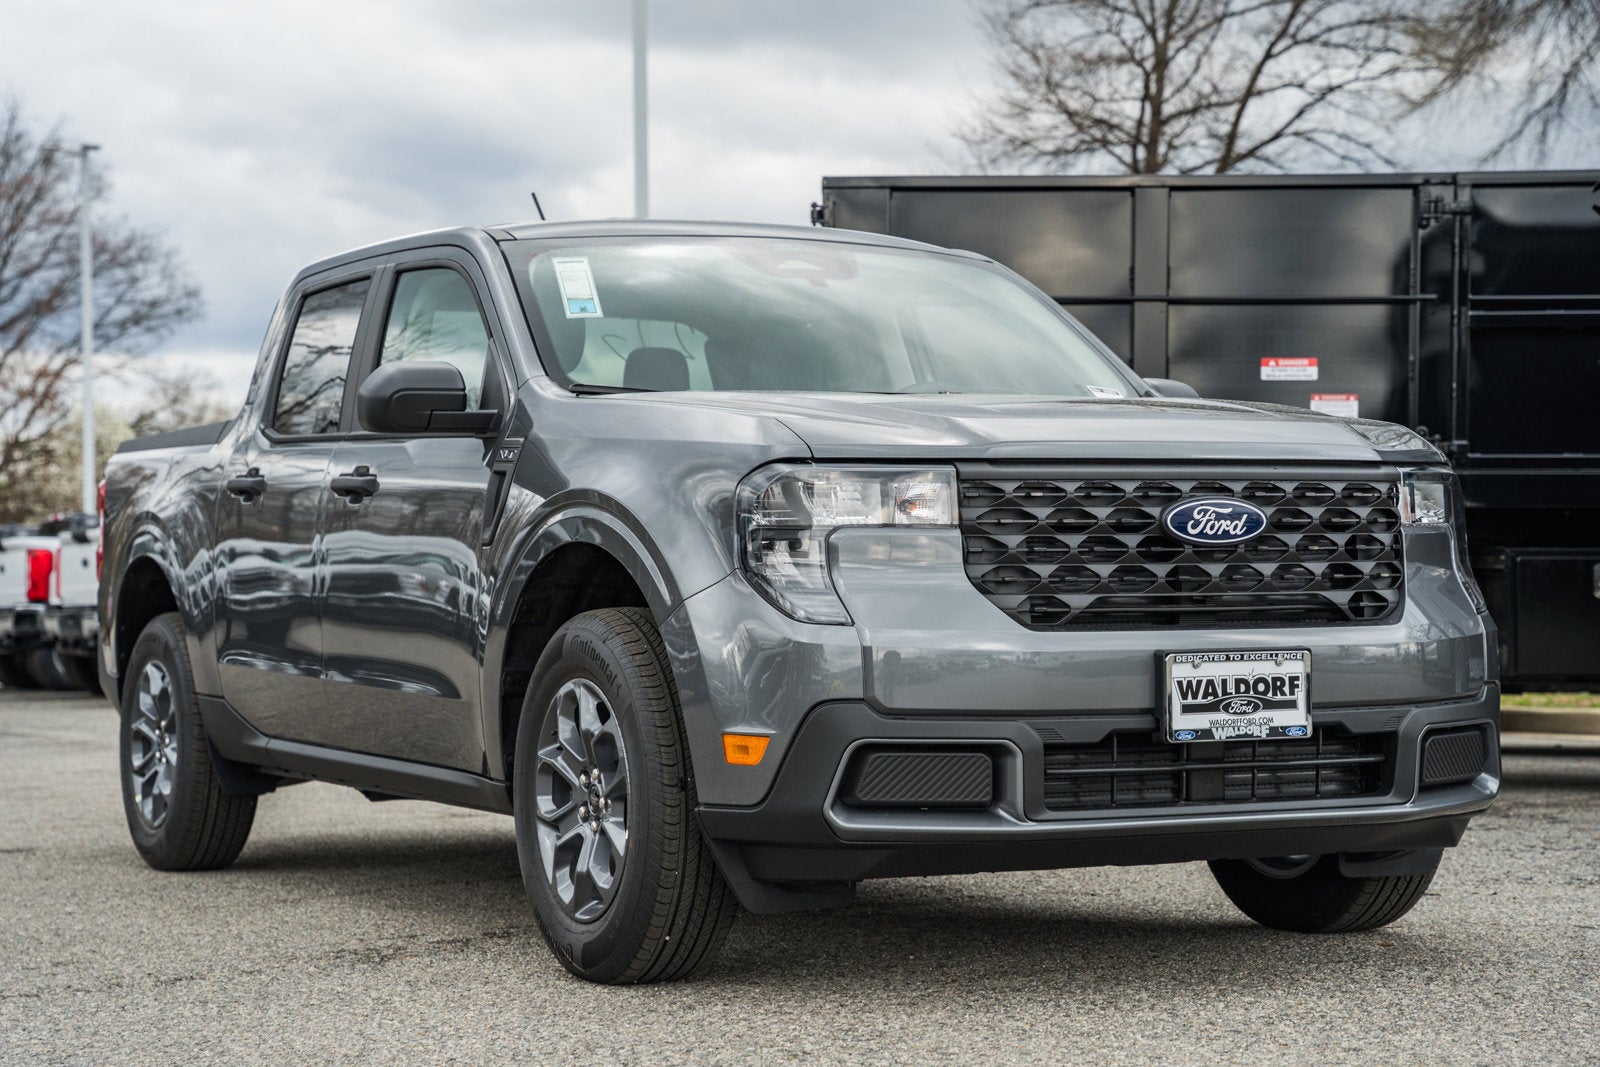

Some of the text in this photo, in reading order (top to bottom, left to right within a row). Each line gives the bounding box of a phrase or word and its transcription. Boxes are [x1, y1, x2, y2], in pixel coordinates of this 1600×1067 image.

[1187, 505, 1248, 535] Ford
[570, 634, 618, 687] Continental
[1176, 654, 1227, 662] DEDICATED
[1243, 652, 1303, 661] EXCELLENCE
[1174, 674, 1302, 701] WALDORF
[1228, 701, 1254, 714] Ford
[1208, 717, 1274, 727] WALDORFFORD.COM
[1211, 724, 1270, 740] WALDORF
